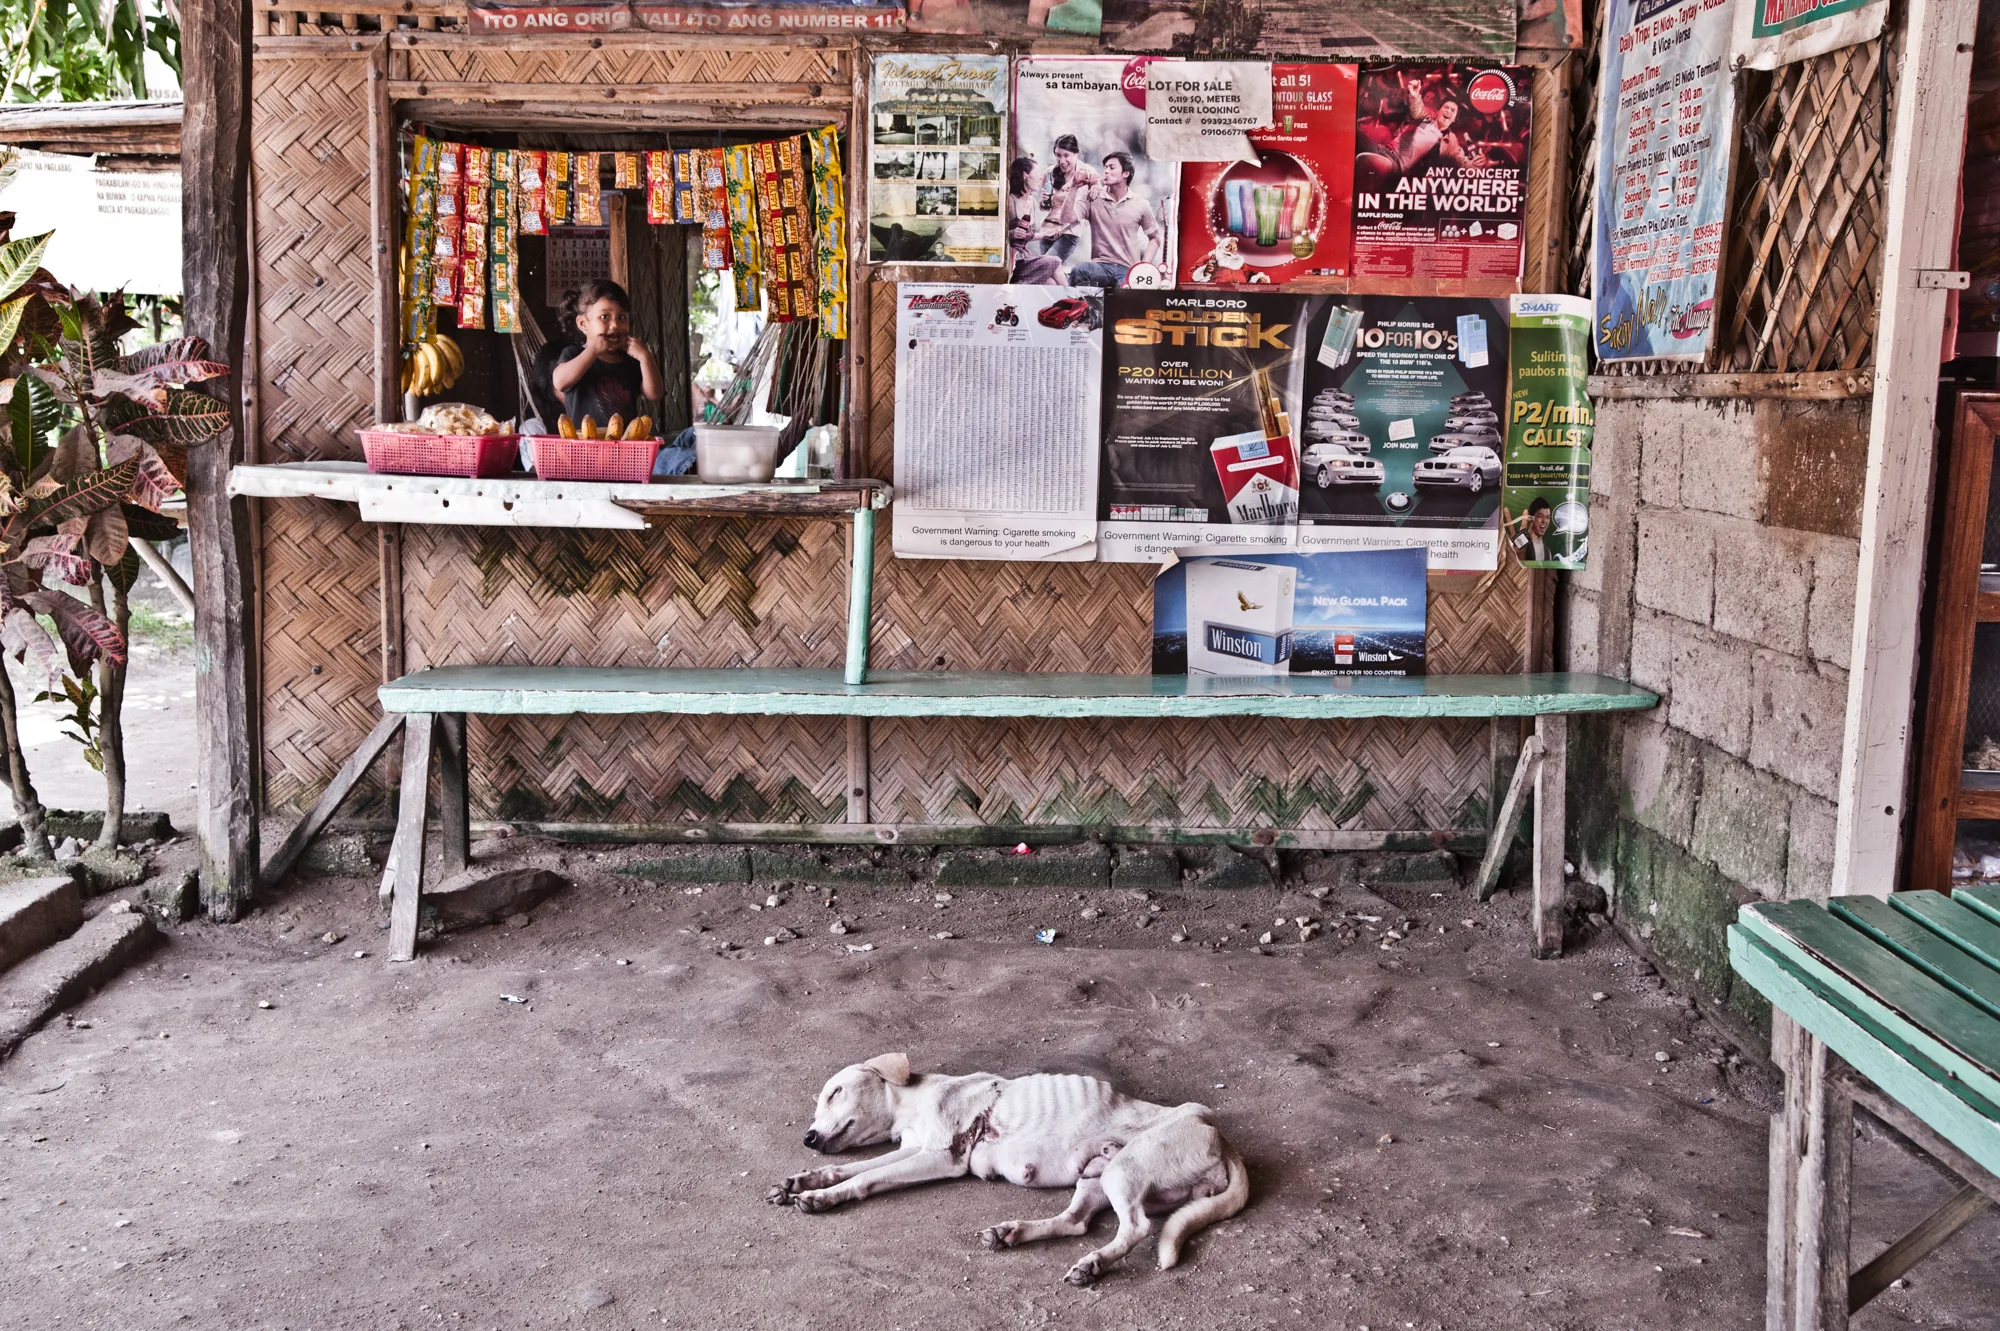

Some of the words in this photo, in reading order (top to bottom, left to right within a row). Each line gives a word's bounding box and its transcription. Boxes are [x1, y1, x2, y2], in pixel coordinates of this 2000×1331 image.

[484, 14, 518, 29] ITO
[524, 12, 569, 27] ANG
[728, 13, 772, 28] ANG
[780, 14, 868, 28] NUMBER
[874, 14, 891, 28] 1!
[1619, 33, 1634, 53] Daily
[1635, 25, 1650, 44] Trip:
[1653, 21, 1659, 37] El
[1660, 15, 1674, 32] Nido
[1679, 3, 1698, 25] Taytay
[1658, 36, 1671, 53] Vice
[1675, 27, 1691, 45] Versa
[880, 60, 943, 79] Island
[944, 61, 998, 81] Front
[1020, 71, 1049, 79] Always
[1052, 72, 1083, 80] present
[1046, 81, 1058, 89] sa
[1062, 81, 1121, 91] tambayan.
[1148, 81, 1172, 91] LOT
[1175, 81, 1200, 91] FOR
[1203, 81, 1232, 91] SALE
[1280, 75, 1296, 86] all
[1299, 75, 1311, 86] 5!
[1620, 73, 1644, 93] Departure
[1645, 65, 1661, 81] Time:
[1306, 91, 1333, 102] GLASS
[1621, 97, 1632, 110] From
[1638, 89, 1649, 102] Nido
[1681, 69, 1695, 84] Nido
[1168, 95, 1188, 104] 6,119
[1190, 95, 1205, 104] SQ.
[1207, 95, 1241, 103] METERS
[1631, 108, 1641, 122] First
[1641, 105, 1652, 120] Trip
[1693, 87, 1703, 99] am
[1169, 106, 1194, 114] OVER
[1197, 106, 1240, 114] LOOKING
[1148, 116, 1183, 125] Contact
[1201, 117, 1258, 125] 09392346767
[1629, 122, 1647, 139] Second
[1647, 119, 1656, 132] Trip
[1679, 106, 1691, 121] 7:00
[1693, 105, 1702, 117] am
[1628, 142, 1638, 155] Last
[1639, 139, 1647, 152] Trip
[1678, 122, 1691, 138] 8:45
[1692, 121, 1700, 133] am
[782, 144, 791, 169] HAPPY
[1672, 142, 1689, 159] NODA
[764, 145, 774, 172] HAPPY
[45, 163, 72, 172] PAGLABAG
[627, 158, 635, 185] HAPPY
[1426, 167, 1454, 178] ANY
[1457, 168, 1520, 179] CONCERT
[787, 180, 795, 206] HAPPY
[1396, 177, 1519, 195] ANYWHERE
[769, 182, 778, 208] HAPPY
[1358, 193, 1380, 209] IN
[1386, 194, 1427, 211] THE
[556, 190, 565, 217] HAPPY
[774, 219, 783, 245] HAPPY
[788, 216, 797, 243] HAPPY
[1648, 220, 1659, 234] Pls.
[1166, 298, 1247, 309] MARLBORO
[1520, 303, 1561, 312] SMART
[1145, 309, 1261, 324] GOLDEN
[1542, 318, 1573, 326] Buddy
[1114, 318, 1292, 350] STICK
[1531, 350, 1566, 362] Sulitin
[1568, 354, 1581, 367] ang
[1158, 368, 1233, 379] MILLION
[1519, 365, 1555, 379] paubos
[1558, 367, 1570, 376] na
[1513, 389, 1528, 399] NEW
[1513, 400, 1593, 428] P2/min.
[1236, 494, 1298, 522] Marlboro
[912, 526, 962, 535] Government
[964, 527, 1000, 537] Warning:
[1003, 528, 1040, 538] Cigarette
[1042, 529, 1076, 539] smoking
[1104, 531, 1160, 540] Government
[1163, 532, 1203, 543] Warning:
[1206, 533, 1247, 544] Cigarette
[1249, 535, 1287, 545] smoking
[950, 538, 992, 548] dangerous
[995, 539, 1003, 547] to
[1005, 541, 1022, 549] your
[1025, 540, 1050, 548] health
[1134, 544, 1141, 552] is
[1302, 536, 1359, 545] Government
[1451, 539, 1490, 549] smoking
[1430, 550, 1458, 559] health
[1313, 596, 1337, 606] NEW
[1340, 596, 1379, 606] GLOBAL
[1381, 596, 1407, 606] PACK
[1211, 628, 1262, 659] Winston
[1359, 652, 1387, 662] Winston
